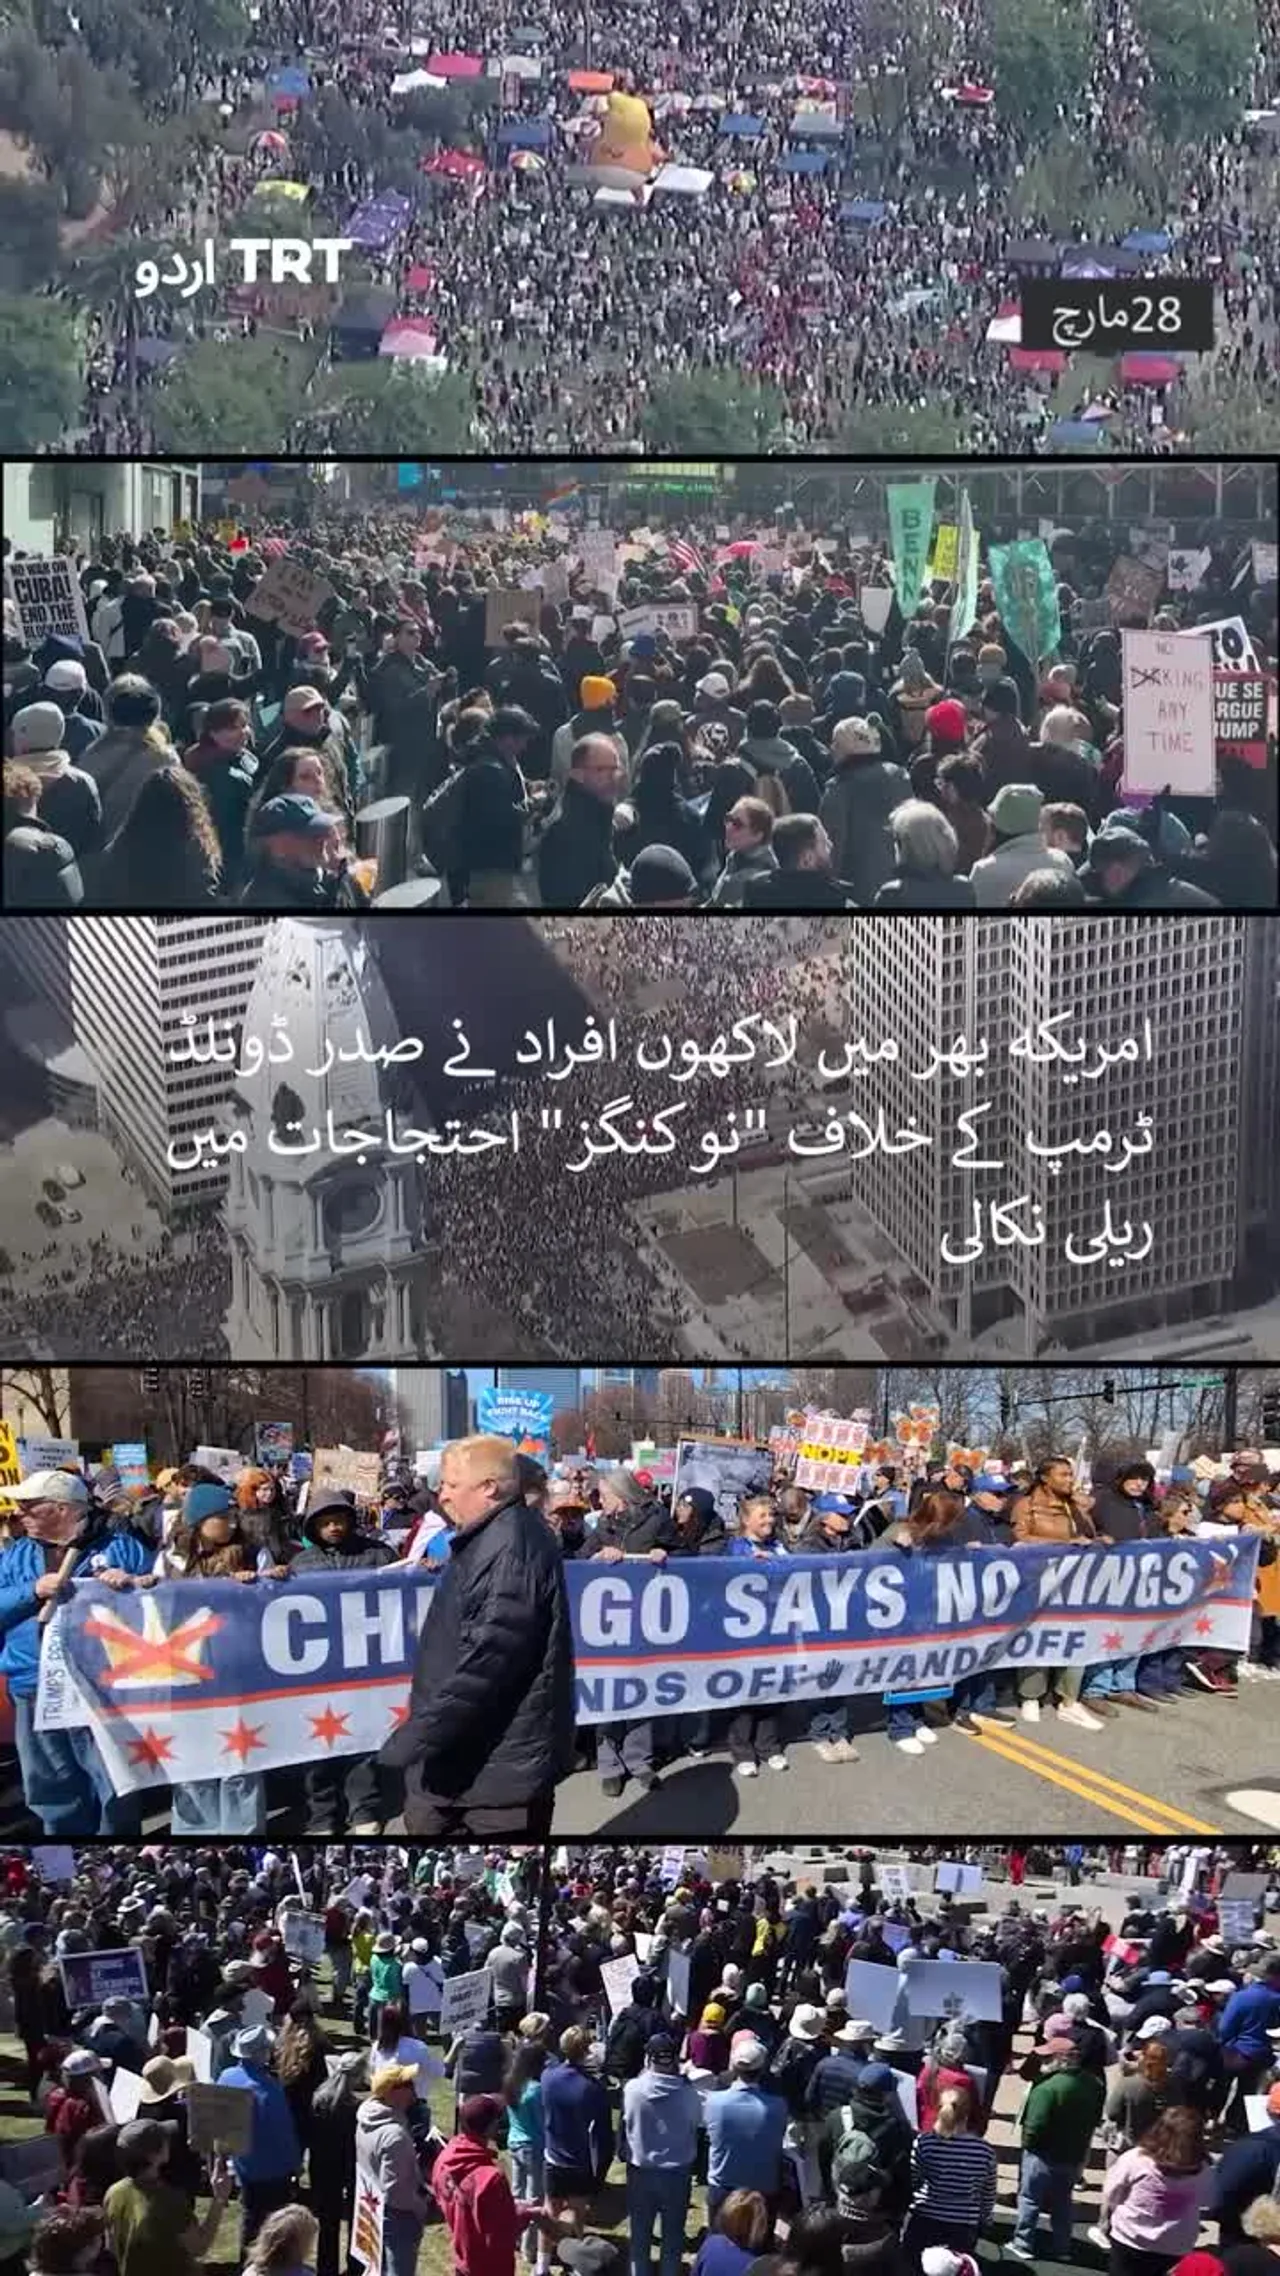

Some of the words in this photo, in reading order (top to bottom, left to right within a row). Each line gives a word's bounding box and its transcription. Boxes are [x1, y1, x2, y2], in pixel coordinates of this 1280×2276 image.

[11, 563, 25, 577] NO
[51, 560, 68, 573] ON
[14, 574, 74, 604] CUBA!
[20, 604, 48, 624] END
[49, 601, 77, 622] THE
[1156, 641, 1174, 656] NO
[1214, 682, 1237, 699] UE
[1242, 681, 1264, 699] SE
[1158, 701, 1189, 722] ANY
[1215, 701, 1264, 719] RGUE
[1213, 721, 1260, 740] UMP
[1146, 731, 1194, 753] TIME
[803, 1441, 862, 1466] NOPE
[723, 1563, 906, 1639] SAYS
[936, 1561, 1021, 1624] NO
[1037, 1552, 1198, 1608] KINGS
[574, 1671, 686, 1713] NDS
[706, 1665, 808, 1701] OFF
[1006, 1629, 1086, 1660] OFF
